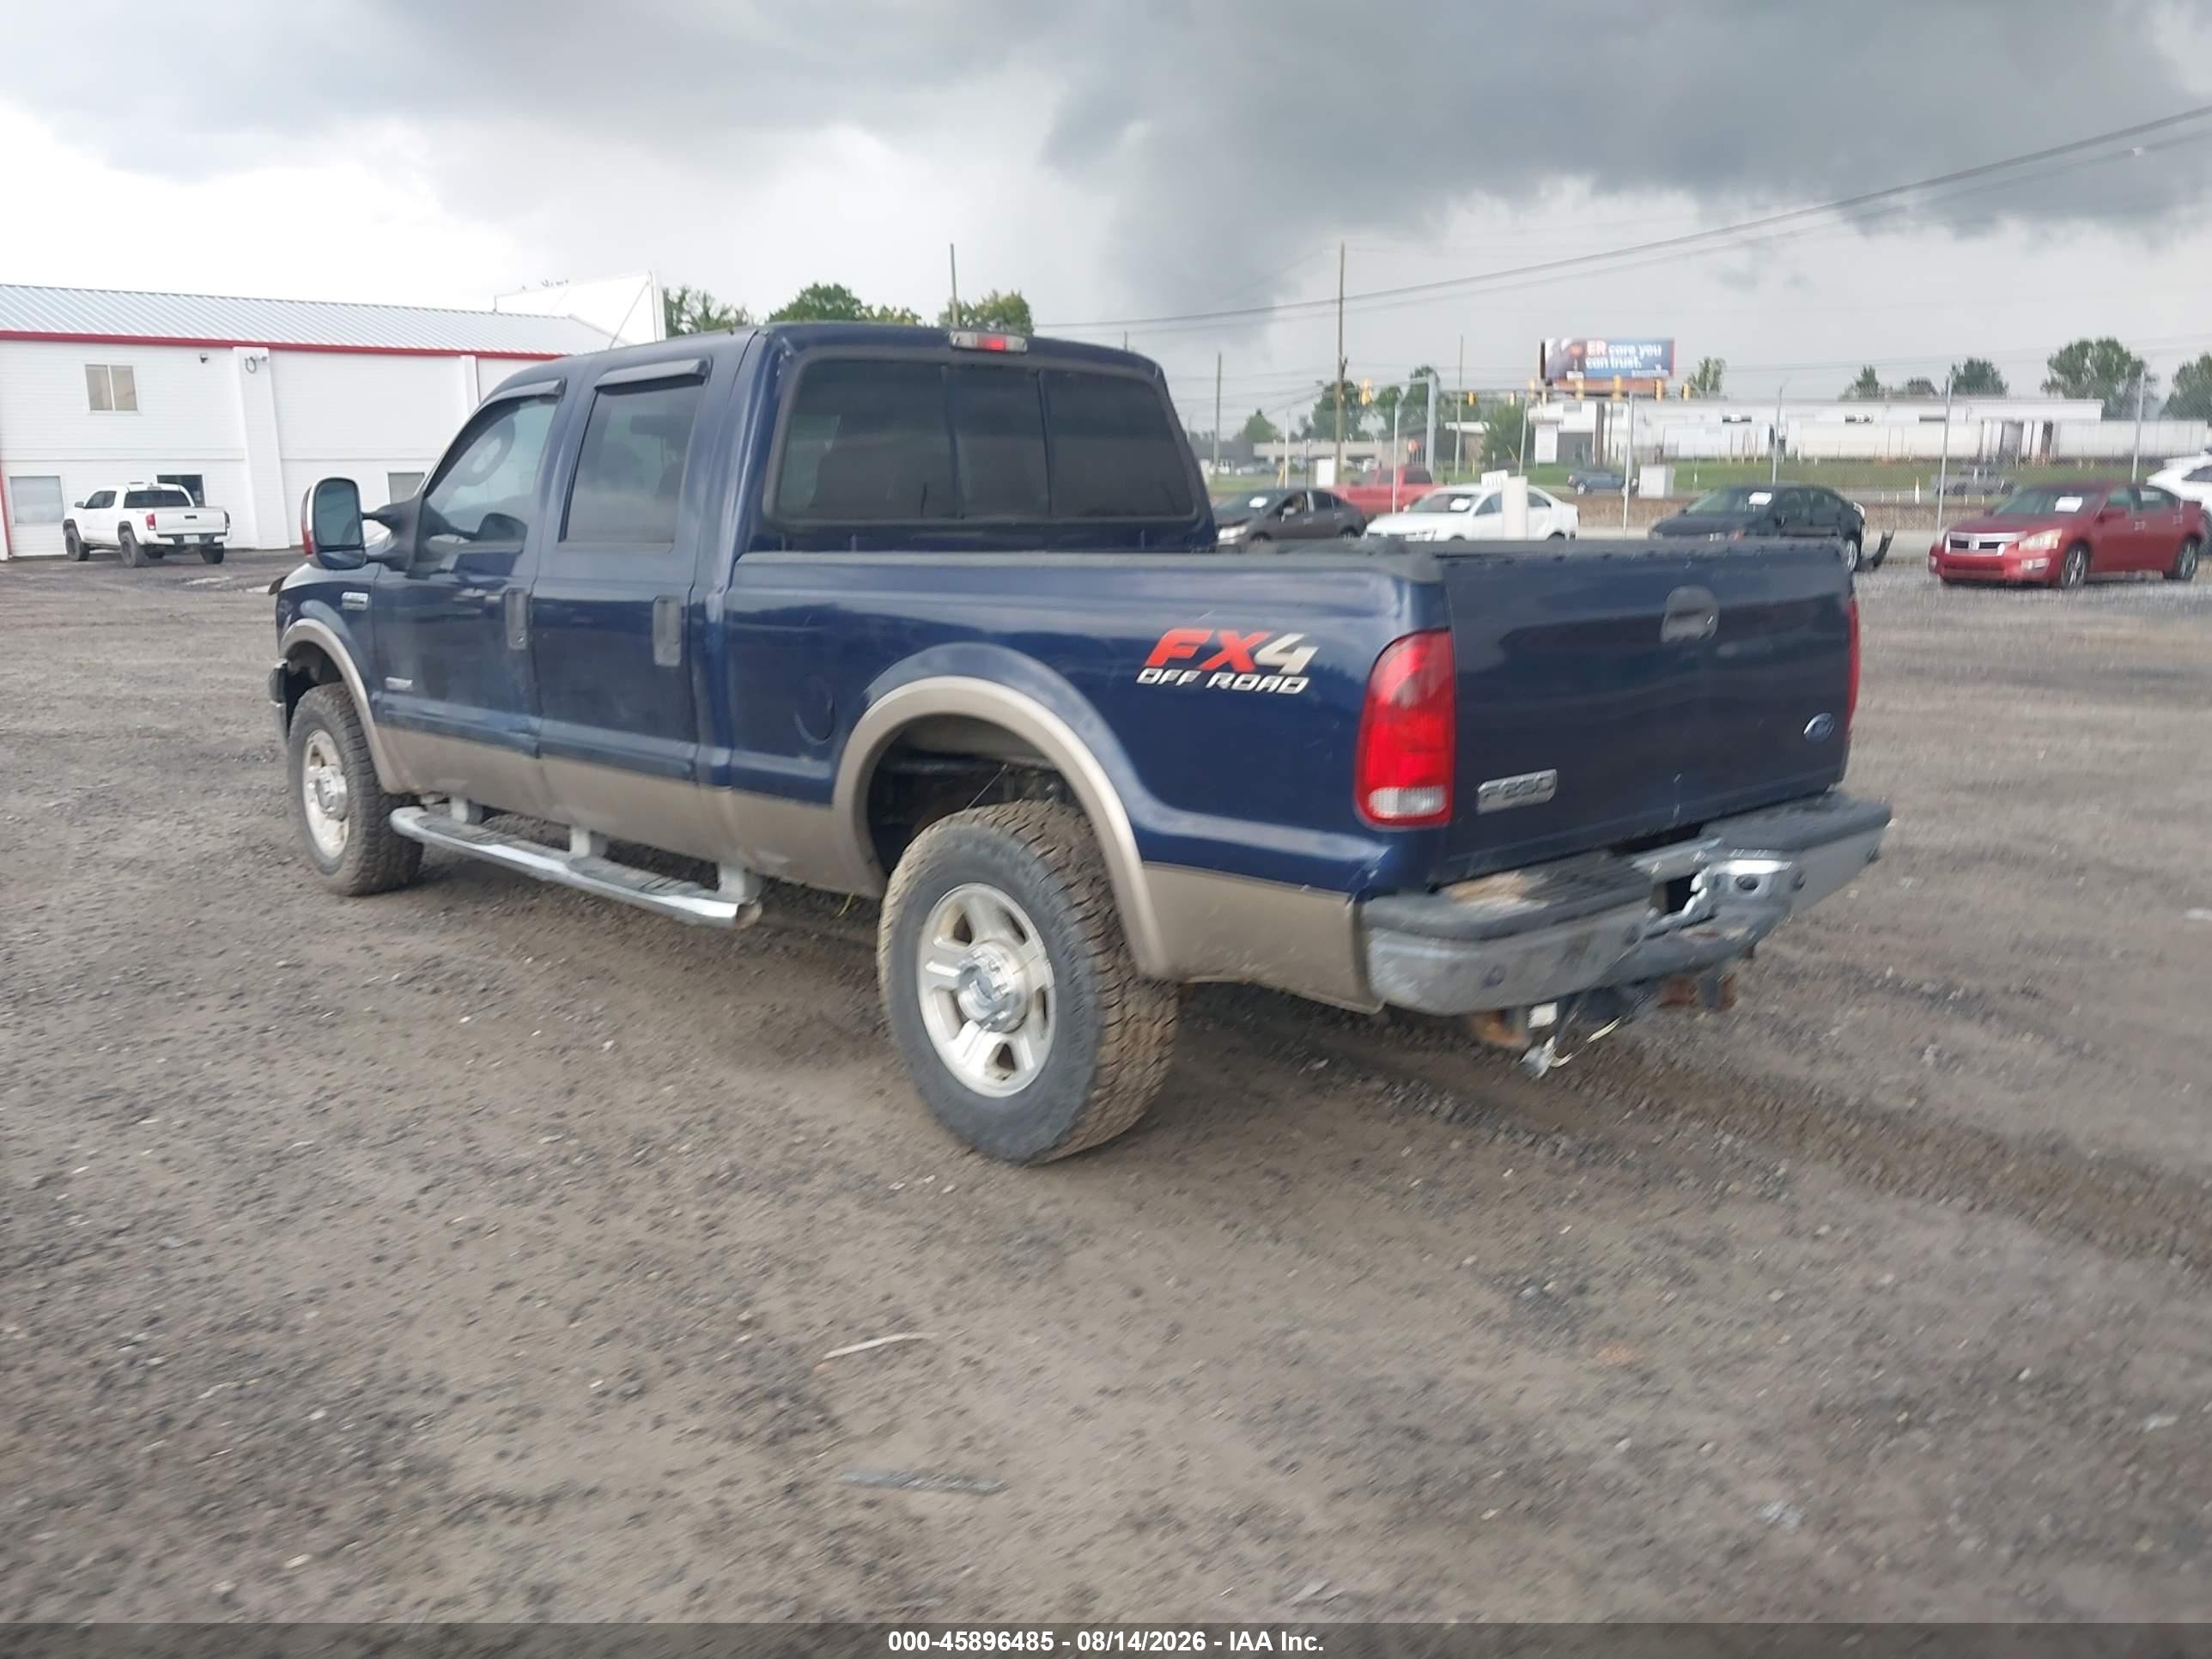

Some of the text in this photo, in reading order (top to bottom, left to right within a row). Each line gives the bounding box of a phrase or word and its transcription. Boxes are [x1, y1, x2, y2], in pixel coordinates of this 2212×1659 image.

[1586, 339, 1662, 360] ER care you
[1585, 357, 1609, 369] can
[1144, 628, 1320, 675] FX4
[1135, 667, 1310, 695] OFF ROAD
